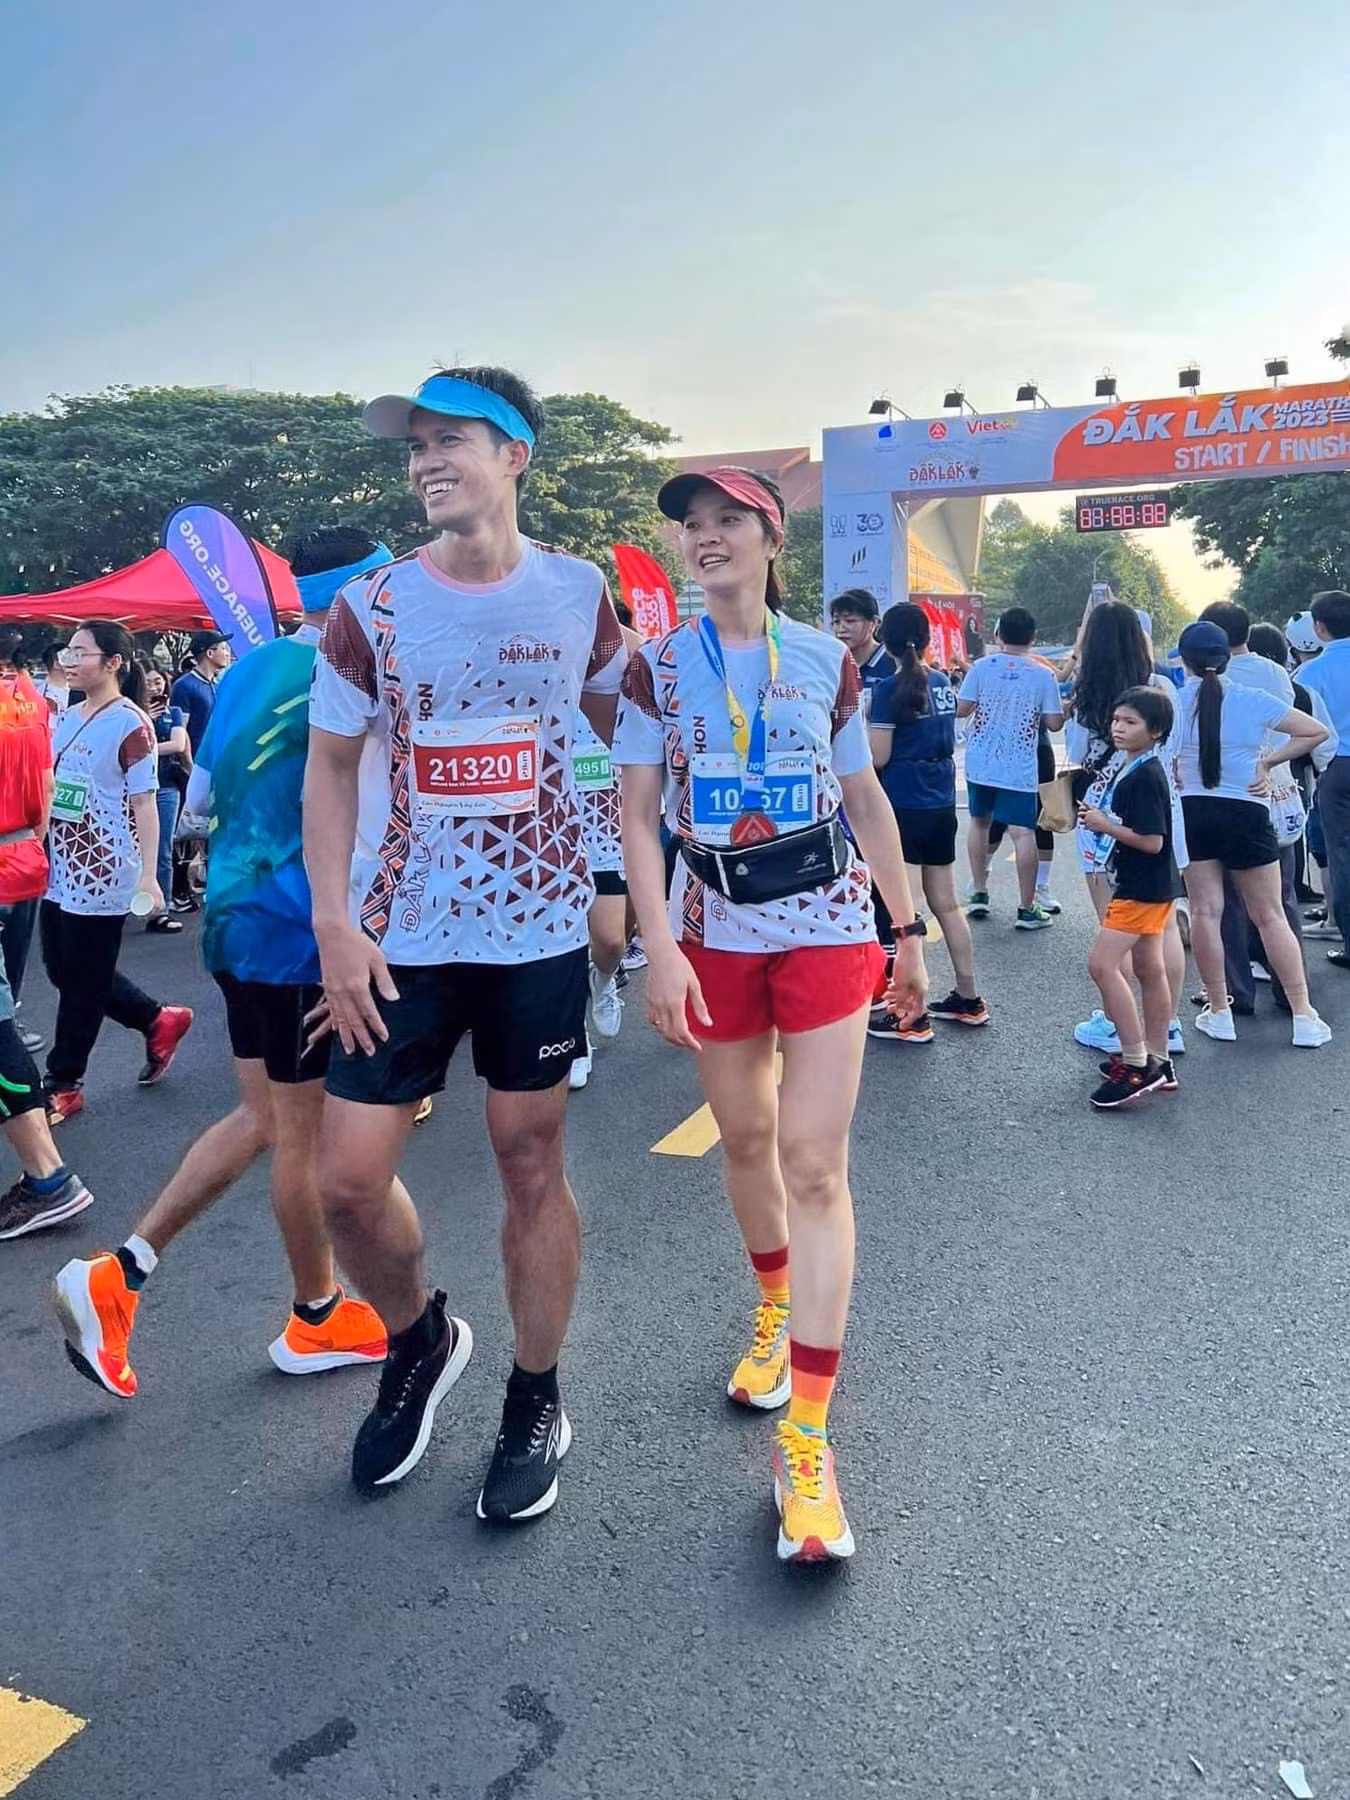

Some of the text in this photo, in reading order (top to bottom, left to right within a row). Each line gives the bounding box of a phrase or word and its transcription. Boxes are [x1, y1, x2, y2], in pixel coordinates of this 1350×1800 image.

[1083, 393, 1275, 446] ĐẮK LẮK
[1272, 409, 1328, 430] 2023
[1174, 440, 1248, 470] START
[429, 755, 512, 781] 21320
[709, 786, 787, 811] 1067
